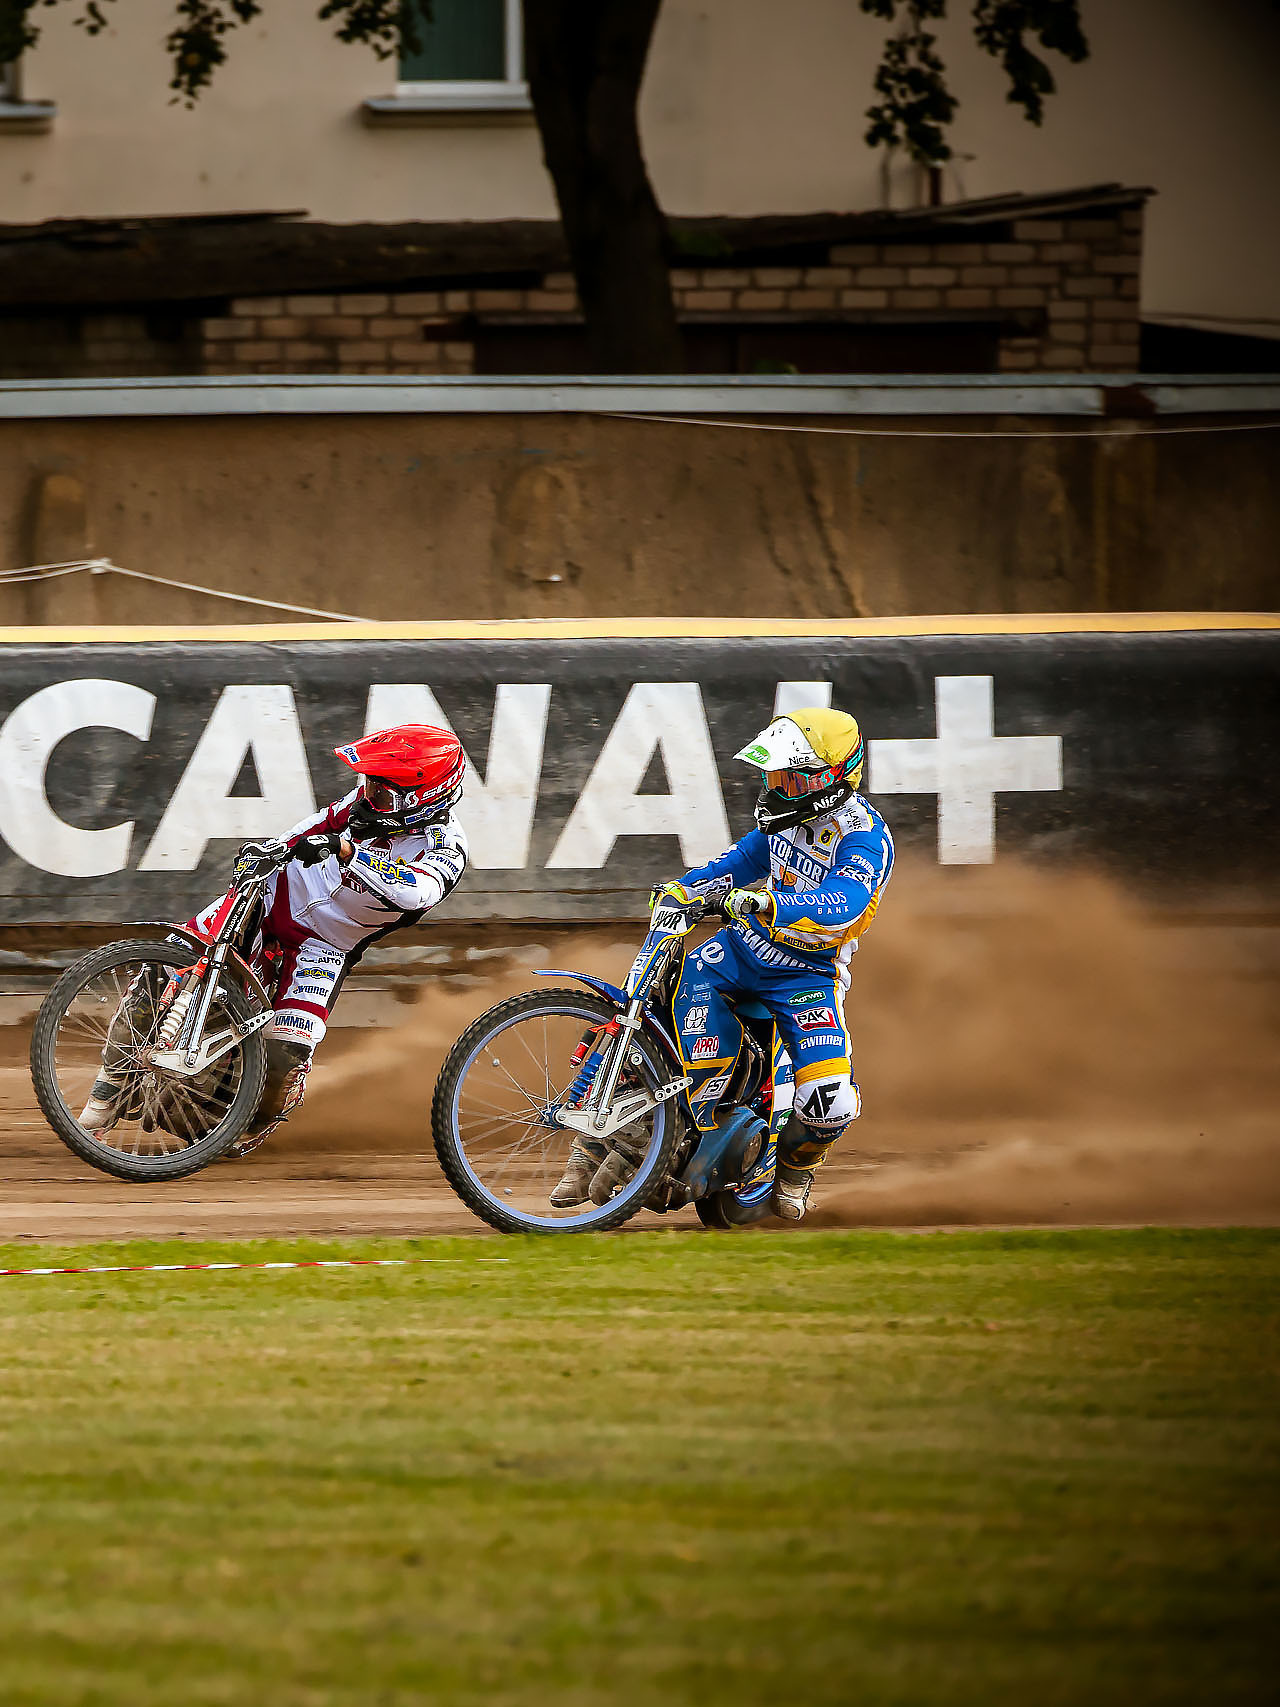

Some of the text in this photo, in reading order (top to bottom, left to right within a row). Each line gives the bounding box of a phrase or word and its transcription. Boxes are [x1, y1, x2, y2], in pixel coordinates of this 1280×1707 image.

[789, 756, 810, 765] Nice
[776, 891, 847, 906] NICOLAUS
[797, 1010, 828, 1024] PAK
